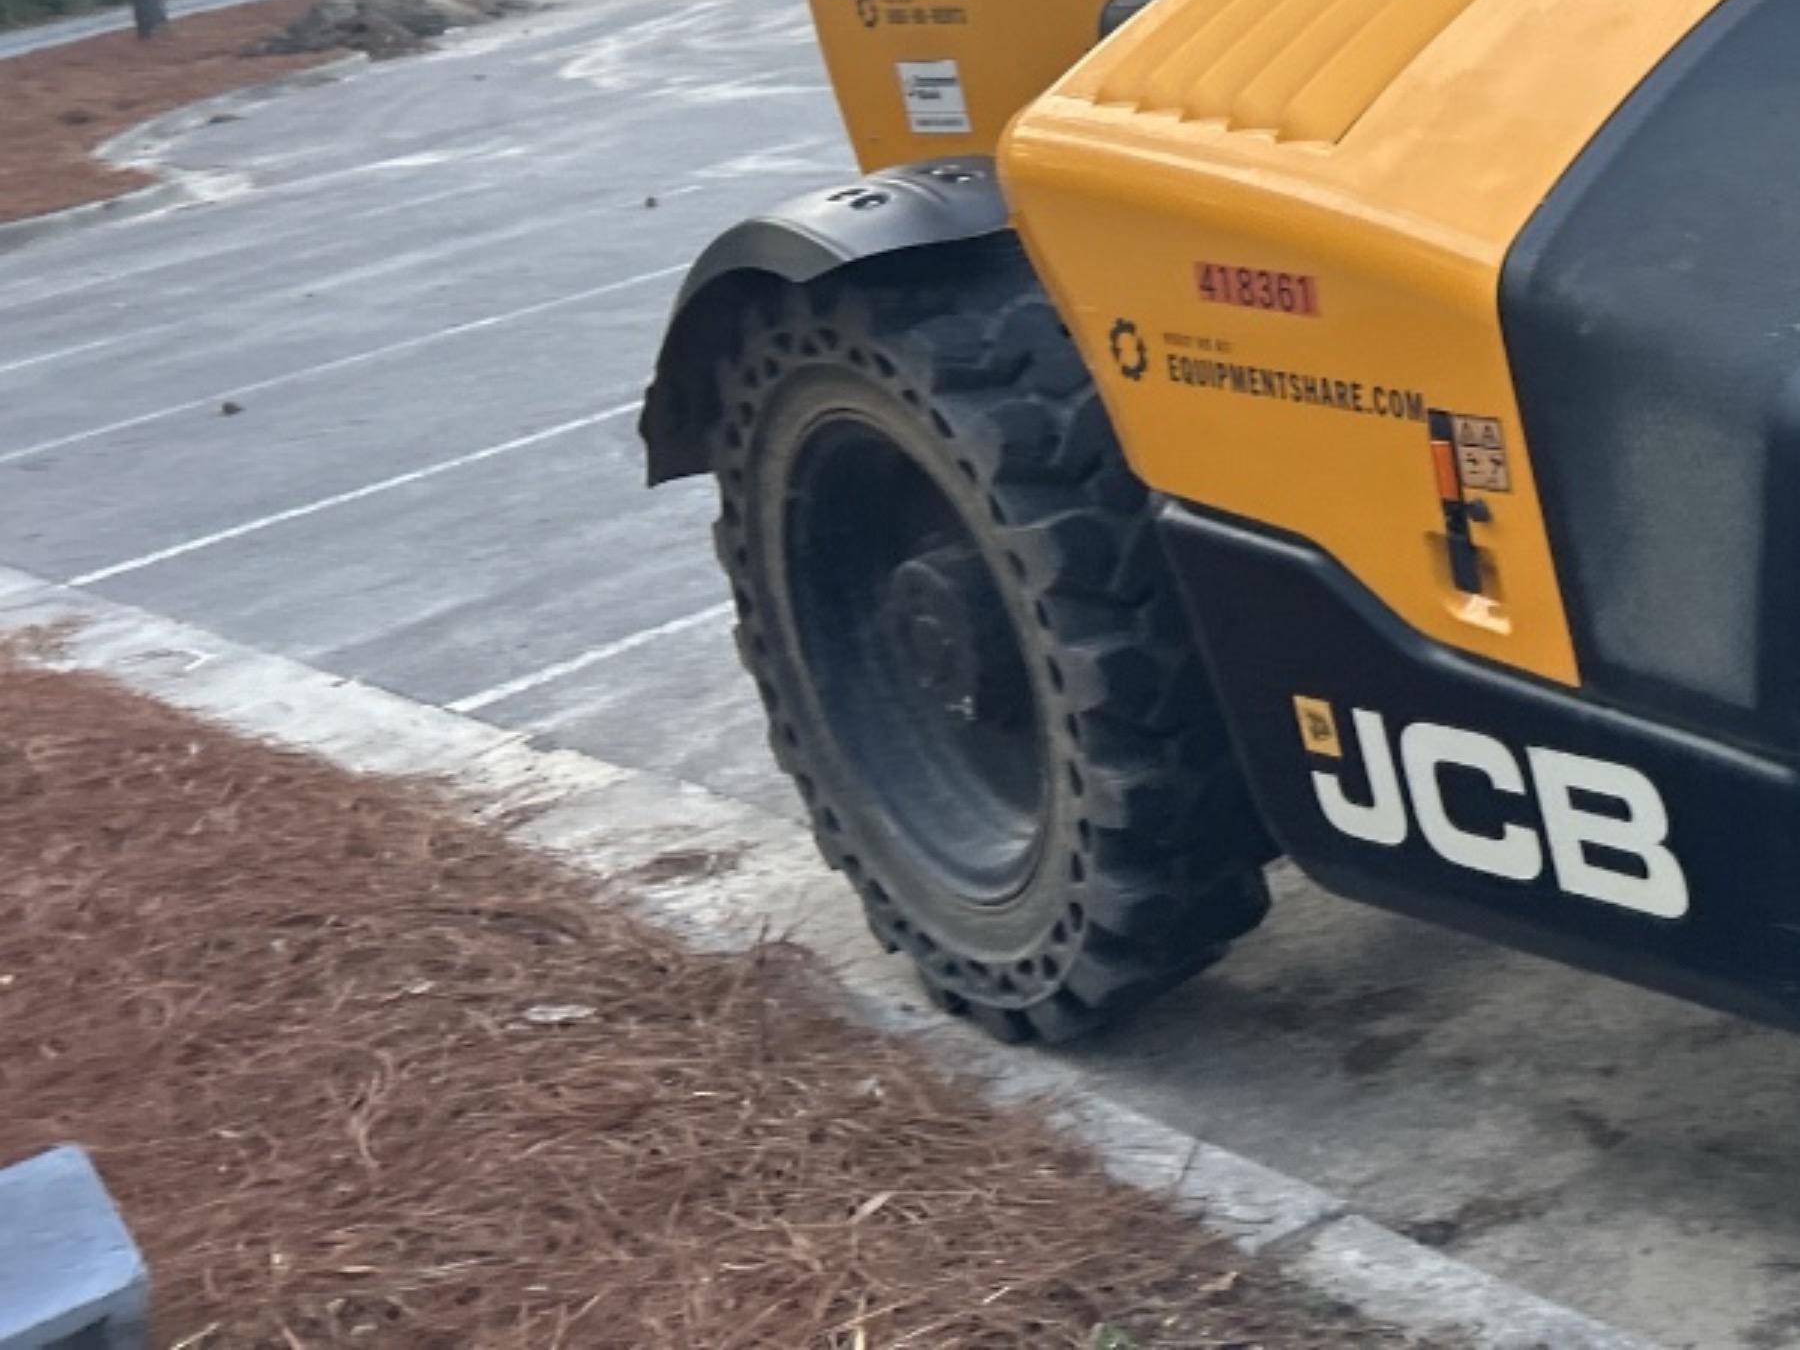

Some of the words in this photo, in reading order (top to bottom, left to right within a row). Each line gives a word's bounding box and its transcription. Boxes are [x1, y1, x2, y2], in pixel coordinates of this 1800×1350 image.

[1198, 263, 1315, 314] 418361
[1165, 352, 1427, 422] EQUIPMENTSHARE.COM
[1310, 706, 1690, 920] JCB
